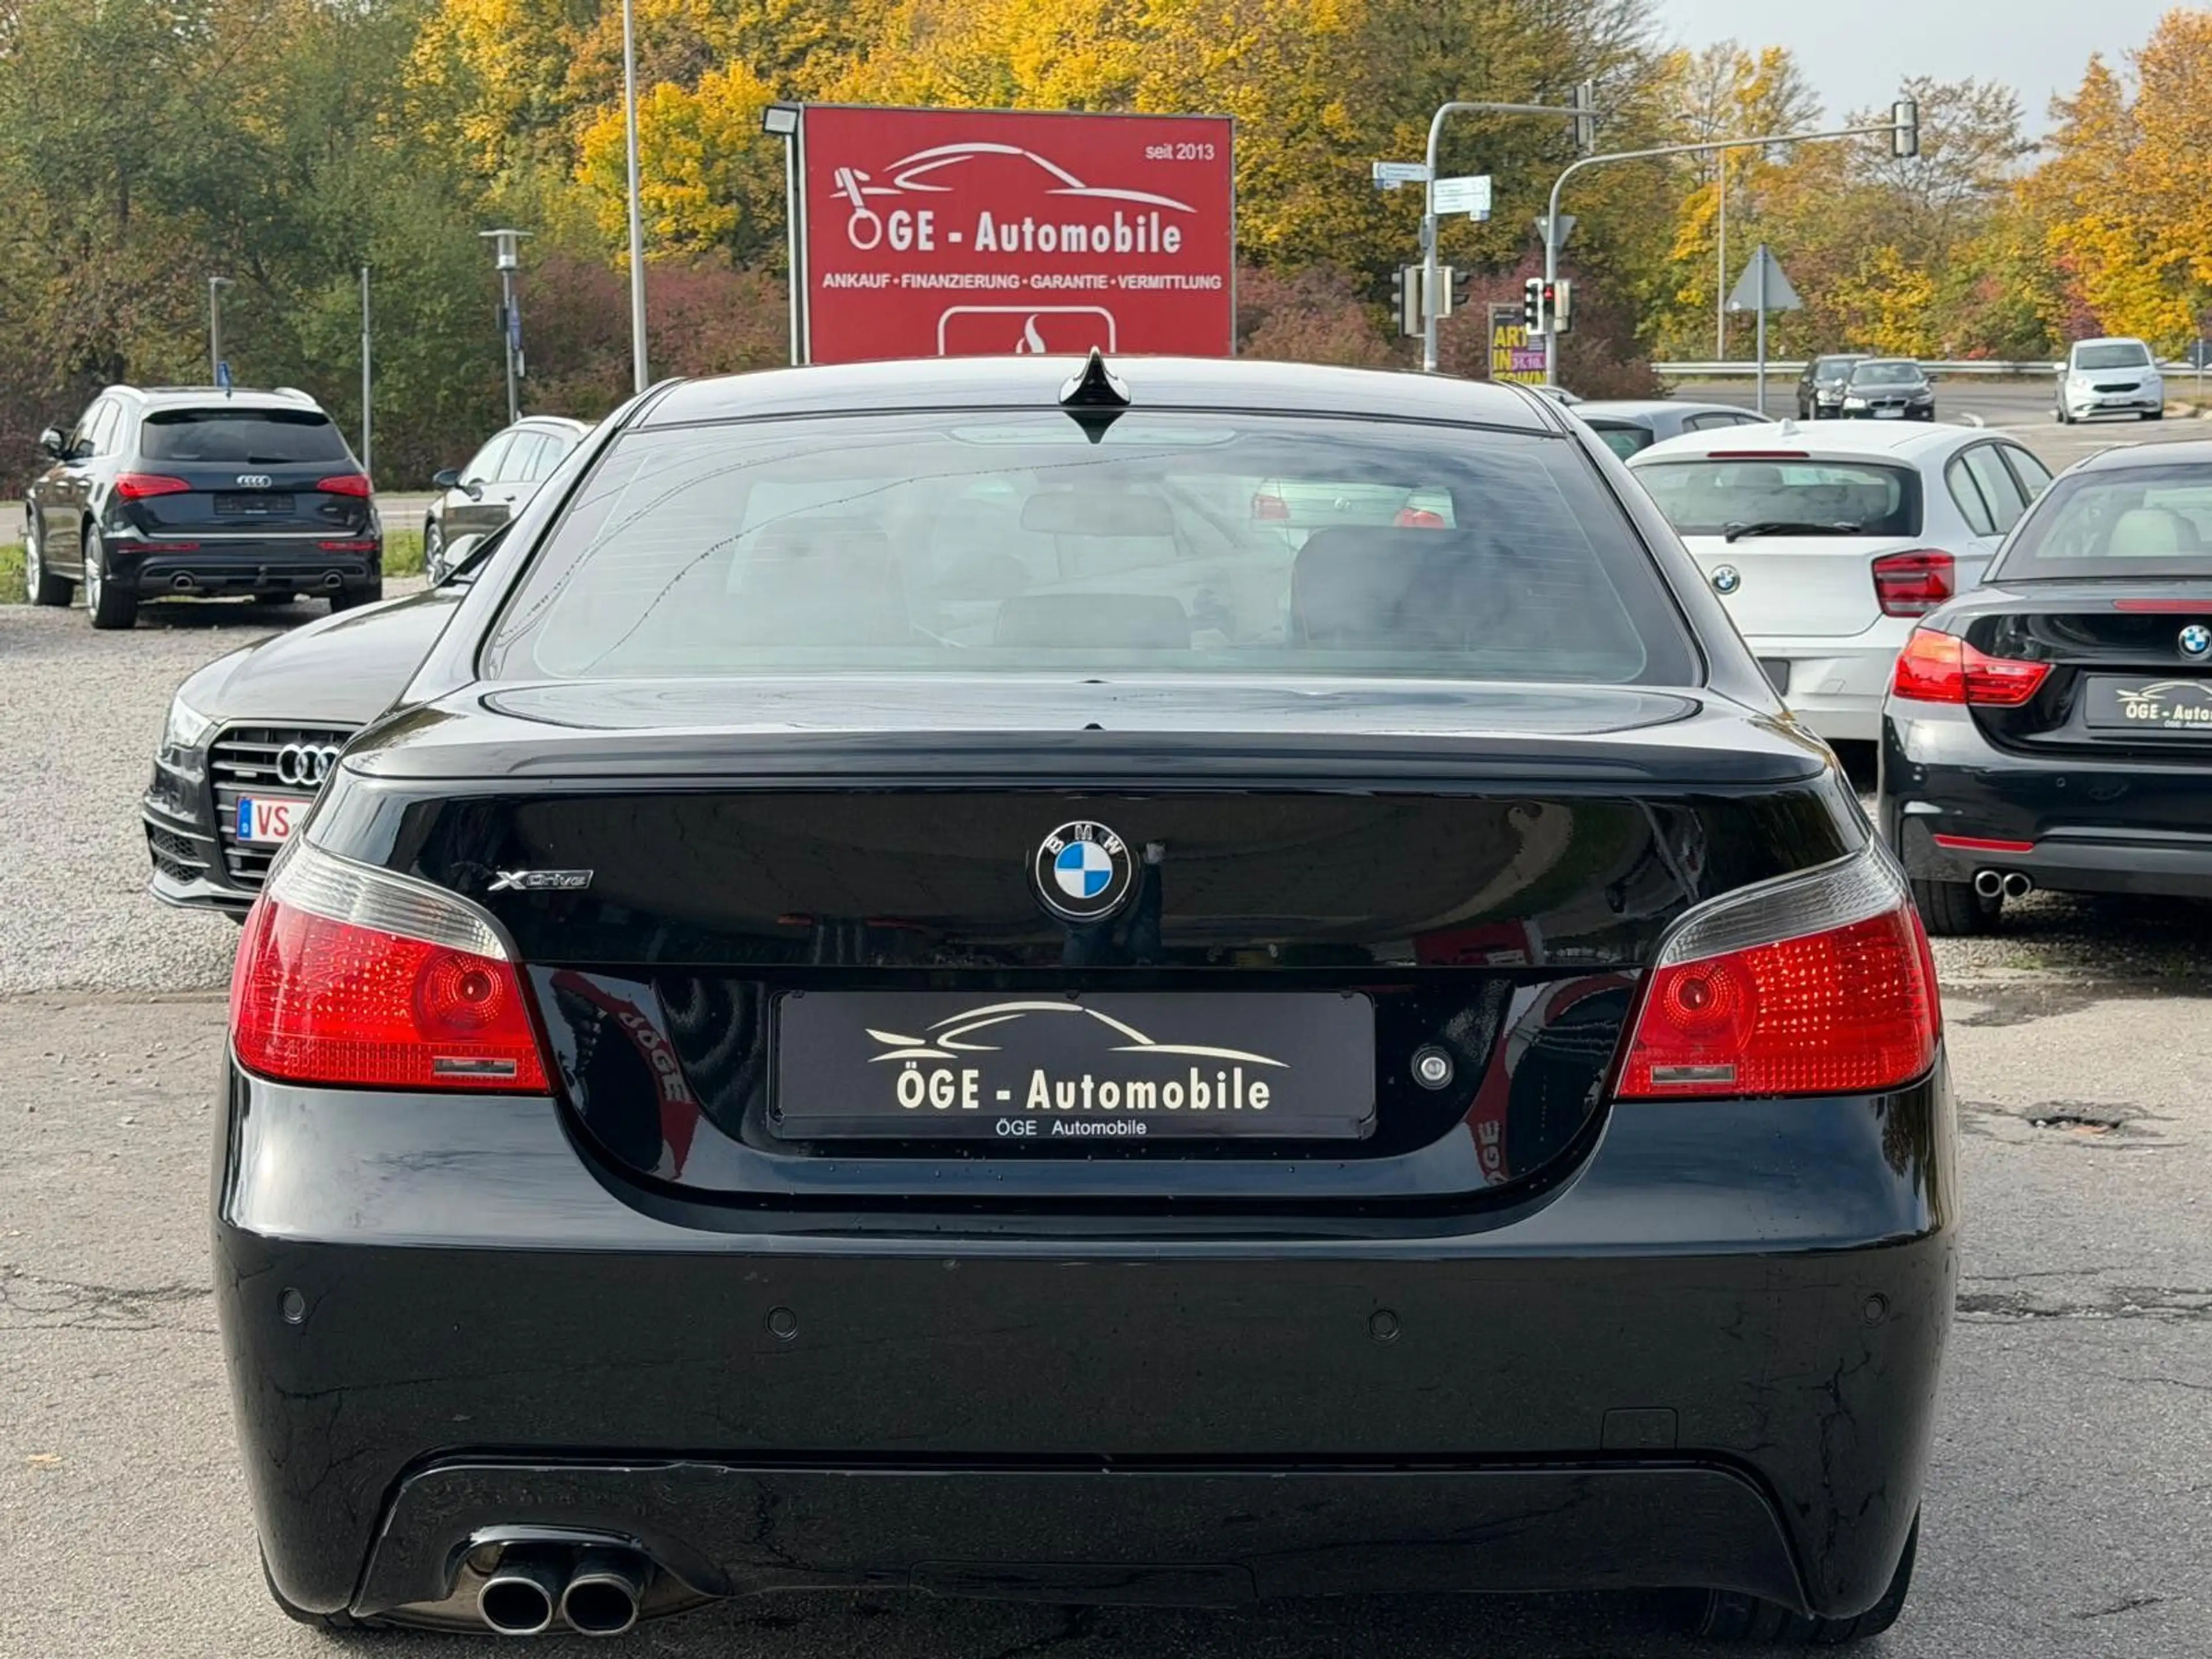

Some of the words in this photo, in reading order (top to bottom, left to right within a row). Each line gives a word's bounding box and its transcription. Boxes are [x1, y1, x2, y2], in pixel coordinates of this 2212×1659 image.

[1145, 143, 1173, 159] seit
[1176, 143, 1215, 160] 2013
[975, 211, 1181, 253] Automobile
[823, 273, 892, 289] ANKAUF
[901, 274, 1020, 289] FINANZIERUNG
[1030, 274, 1108, 289] GARANTIE
[1118, 275, 1222, 290] VERMITTLUNG
[2173, 703, 2212, 721] Auto
[257, 805, 289, 837] VS
[1046, 824, 1122, 855] BMW
[897, 1060, 979, 1109] ÖGE
[1026, 1067, 1270, 1109] Automobile
[996, 1118, 1037, 1136] ÖGE
[1051, 1119, 1147, 1135] Automobile
